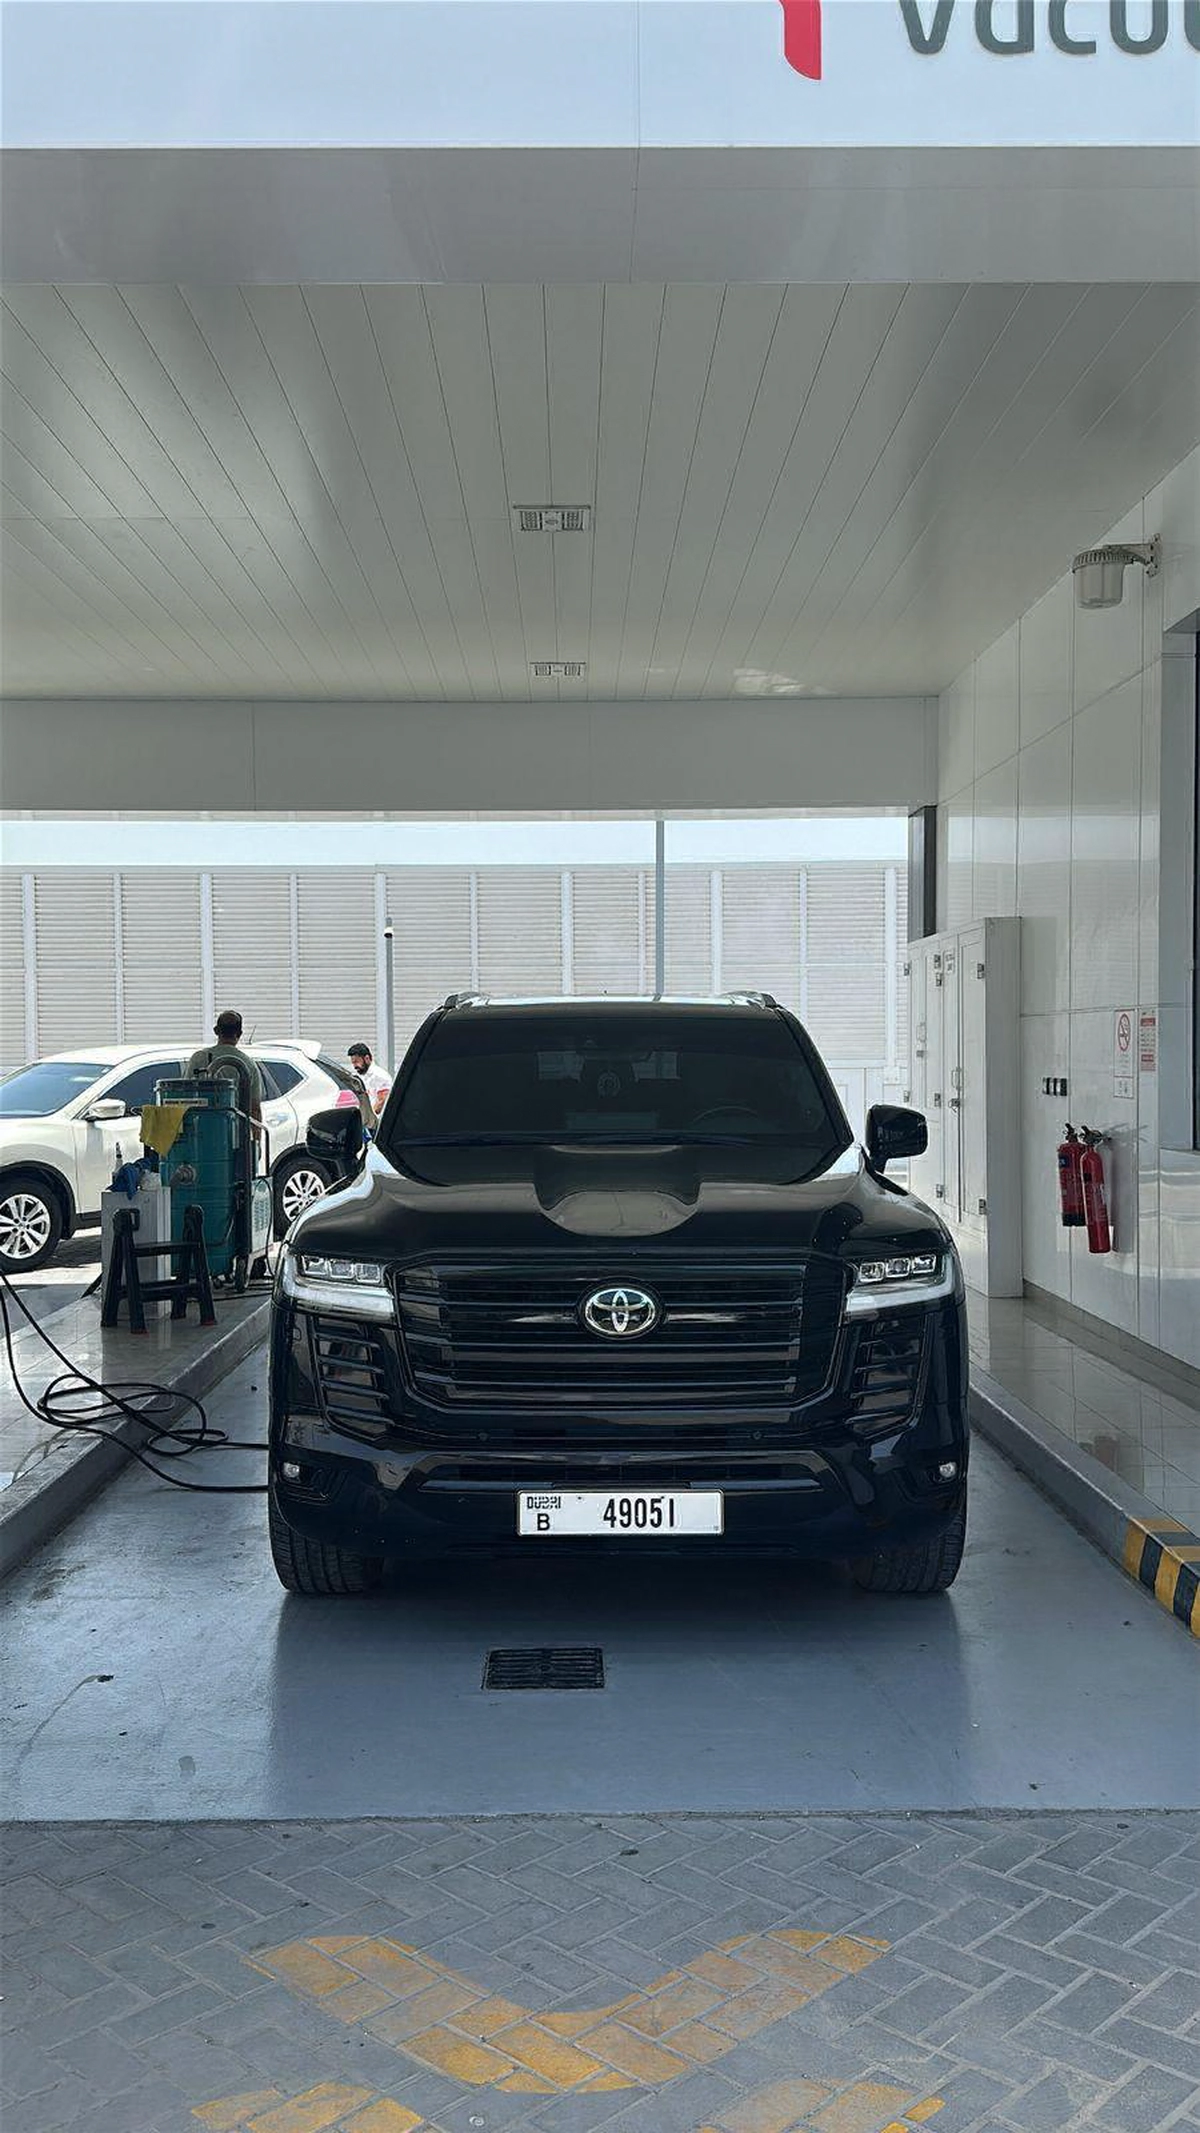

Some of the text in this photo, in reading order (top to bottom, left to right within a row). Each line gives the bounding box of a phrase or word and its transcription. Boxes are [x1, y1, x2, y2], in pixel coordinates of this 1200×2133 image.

[900, 0, 1200, 55] vacu
[536, 1513, 551, 1532] B
[603, 1497, 675, 1528] 49051
